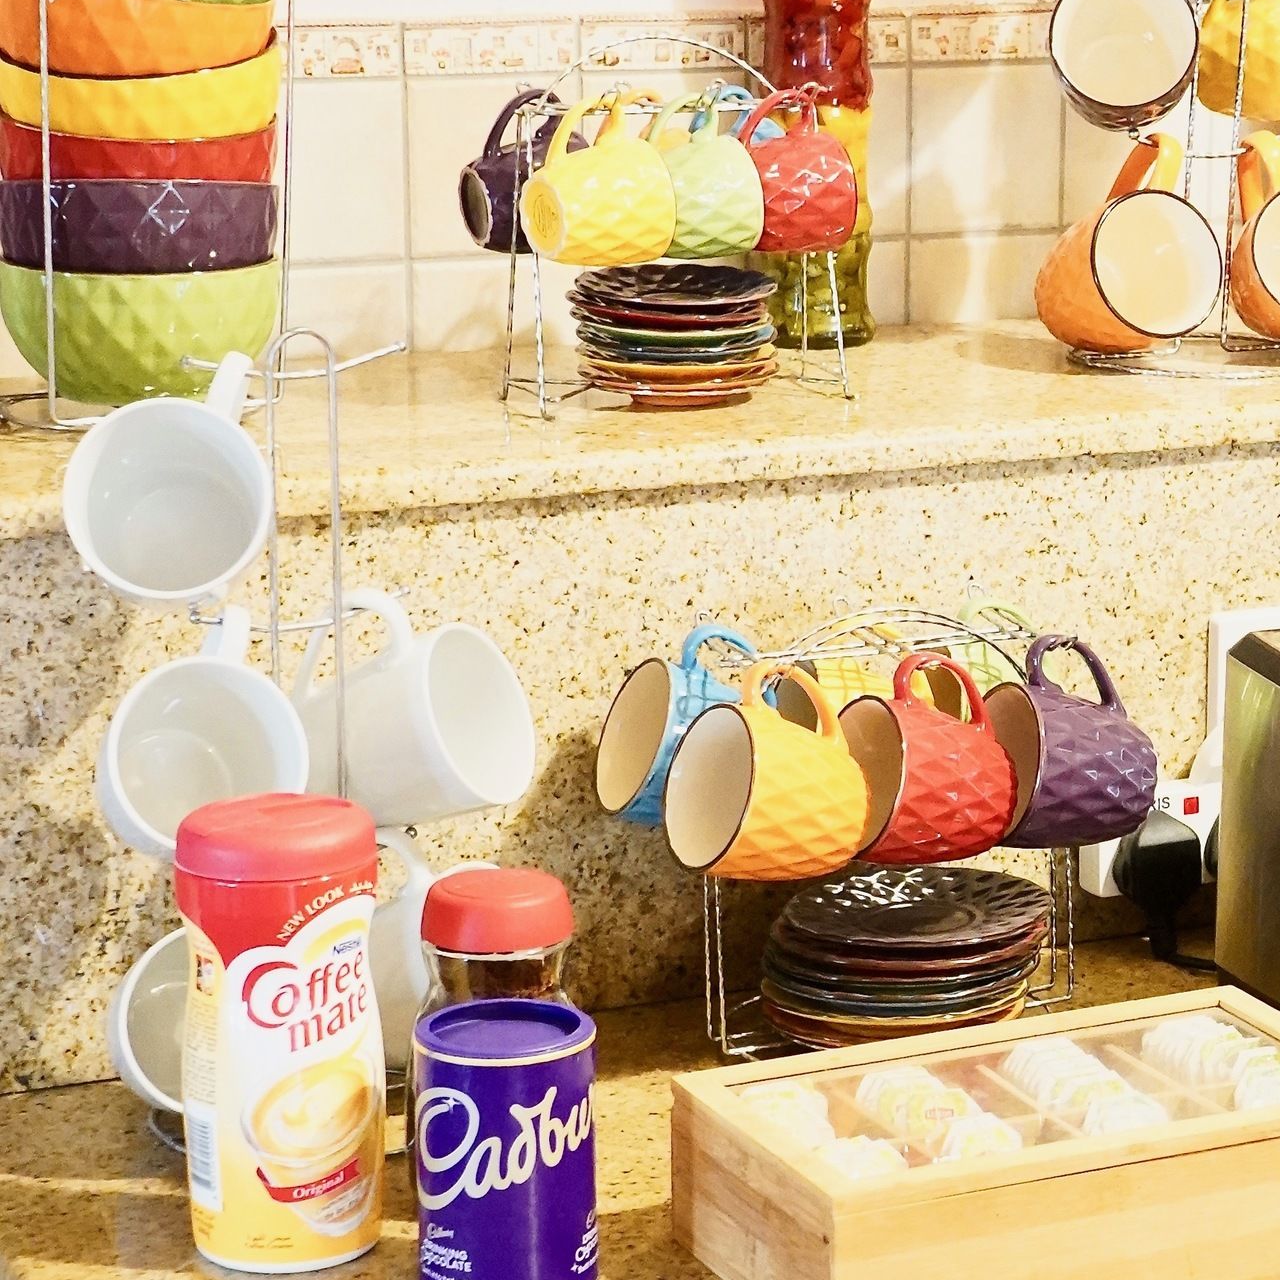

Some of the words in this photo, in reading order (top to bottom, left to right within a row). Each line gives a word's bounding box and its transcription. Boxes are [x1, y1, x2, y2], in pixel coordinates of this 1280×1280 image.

[276, 910, 305, 941] NEW
[305, 885, 345, 915] LOOK
[242, 951, 363, 1028] Coffee
[288, 983, 367, 1052] mate
[292, 1170, 345, 1199] Original
